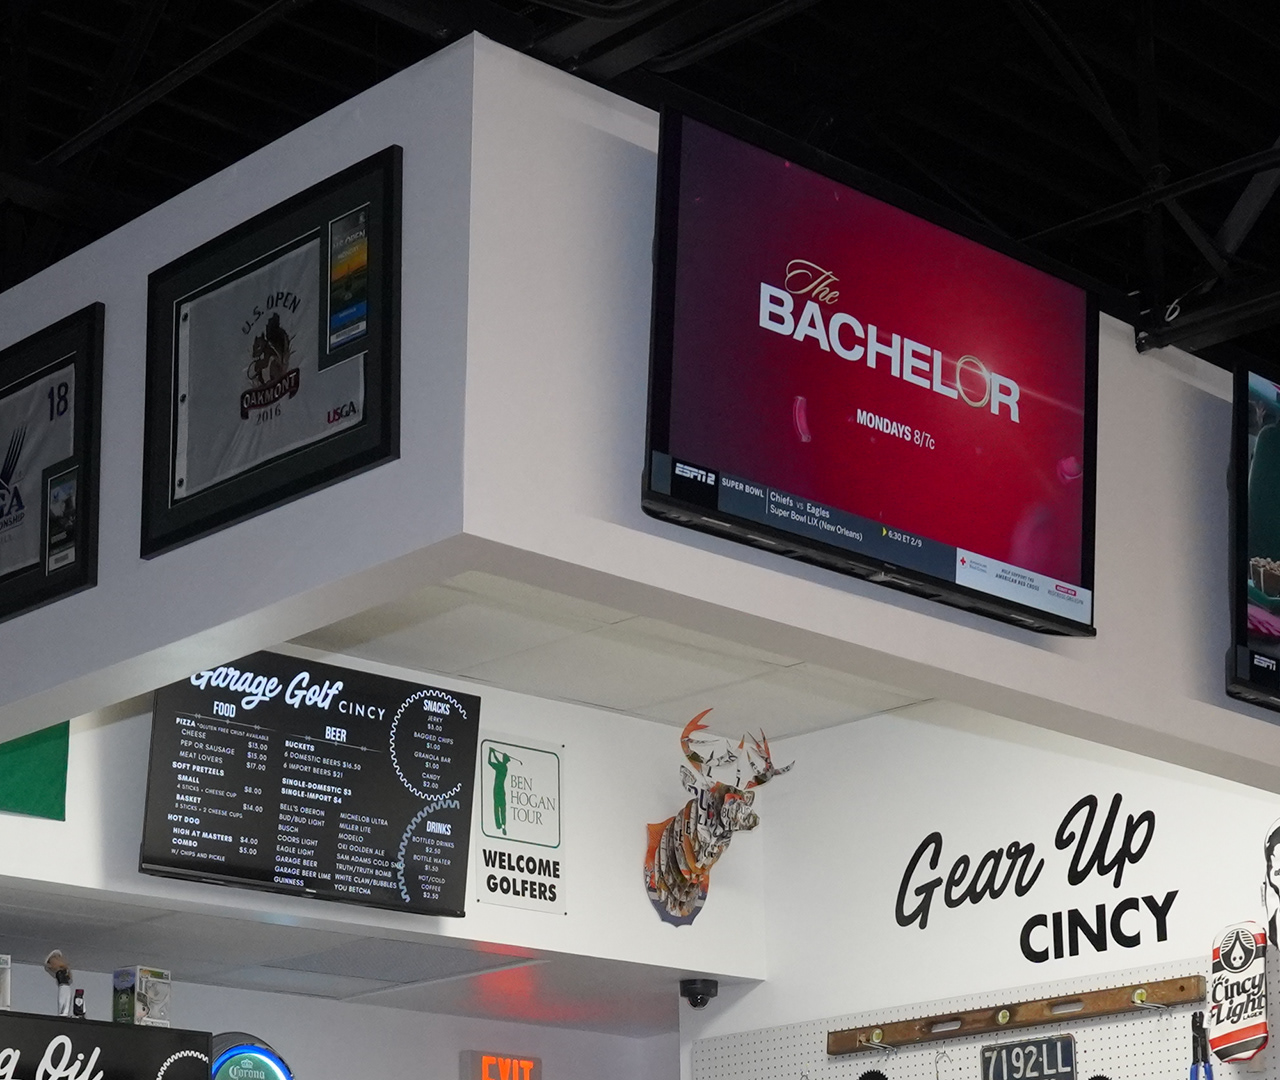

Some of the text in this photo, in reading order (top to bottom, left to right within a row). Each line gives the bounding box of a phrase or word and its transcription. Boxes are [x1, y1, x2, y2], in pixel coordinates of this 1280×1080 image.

[785, 259, 840, 304] The
[242, 292, 301, 335] U.S. OPEN
[759, 282, 1020, 423] BACHELOR
[243, 371, 297, 408] OAKMONT
[48, 382, 69, 421] 18
[327, 401, 357, 423] USGA
[256, 404, 281, 425] 2016
[857, 409, 935, 450] MONDAYS 8/7c
[722, 477, 765, 498] SUPER BOWL
[770, 491, 830, 518] Chiefs vs Eagles
[770, 504, 863, 541] Super Bowl LIX (New Orleans)
[888, 530, 922, 547] 6:30 ET 2/9
[190, 667, 343, 710] Garage Golf
[213, 701, 236, 717] FOOD
[339, 701, 386, 720] CINCY
[424, 700, 450, 715] SNACKS
[325, 726, 347, 742] BEER
[180, 751, 223, 763] MEAT LOVERS
[172, 761, 225, 776] SOFT PRETZELS
[177, 774, 199, 783] SMALL
[511, 775, 532, 791] BEN
[511, 790, 555, 811] HOGAN
[511, 806, 543, 825] TOUR
[339, 823, 359, 832] MILLER
[427, 821, 451, 835] DRINKS
[277, 835, 318, 846] COORS LIGHT
[276, 855, 317, 867] GARAGE BEER
[483, 849, 560, 878] WELCOME
[895, 792, 1156, 930] Gear Up
[349, 886, 371, 895] BETCHA
[487, 874, 557, 902] GOLFERS
[1020, 890, 1179, 964] CINCY
[1212, 971, 1264, 1003] Cincy
[1212, 994, 1266, 1026] Light
[1243, 1011, 1262, 1021] LAGER
[229, 1065, 265, 1080] Corona
